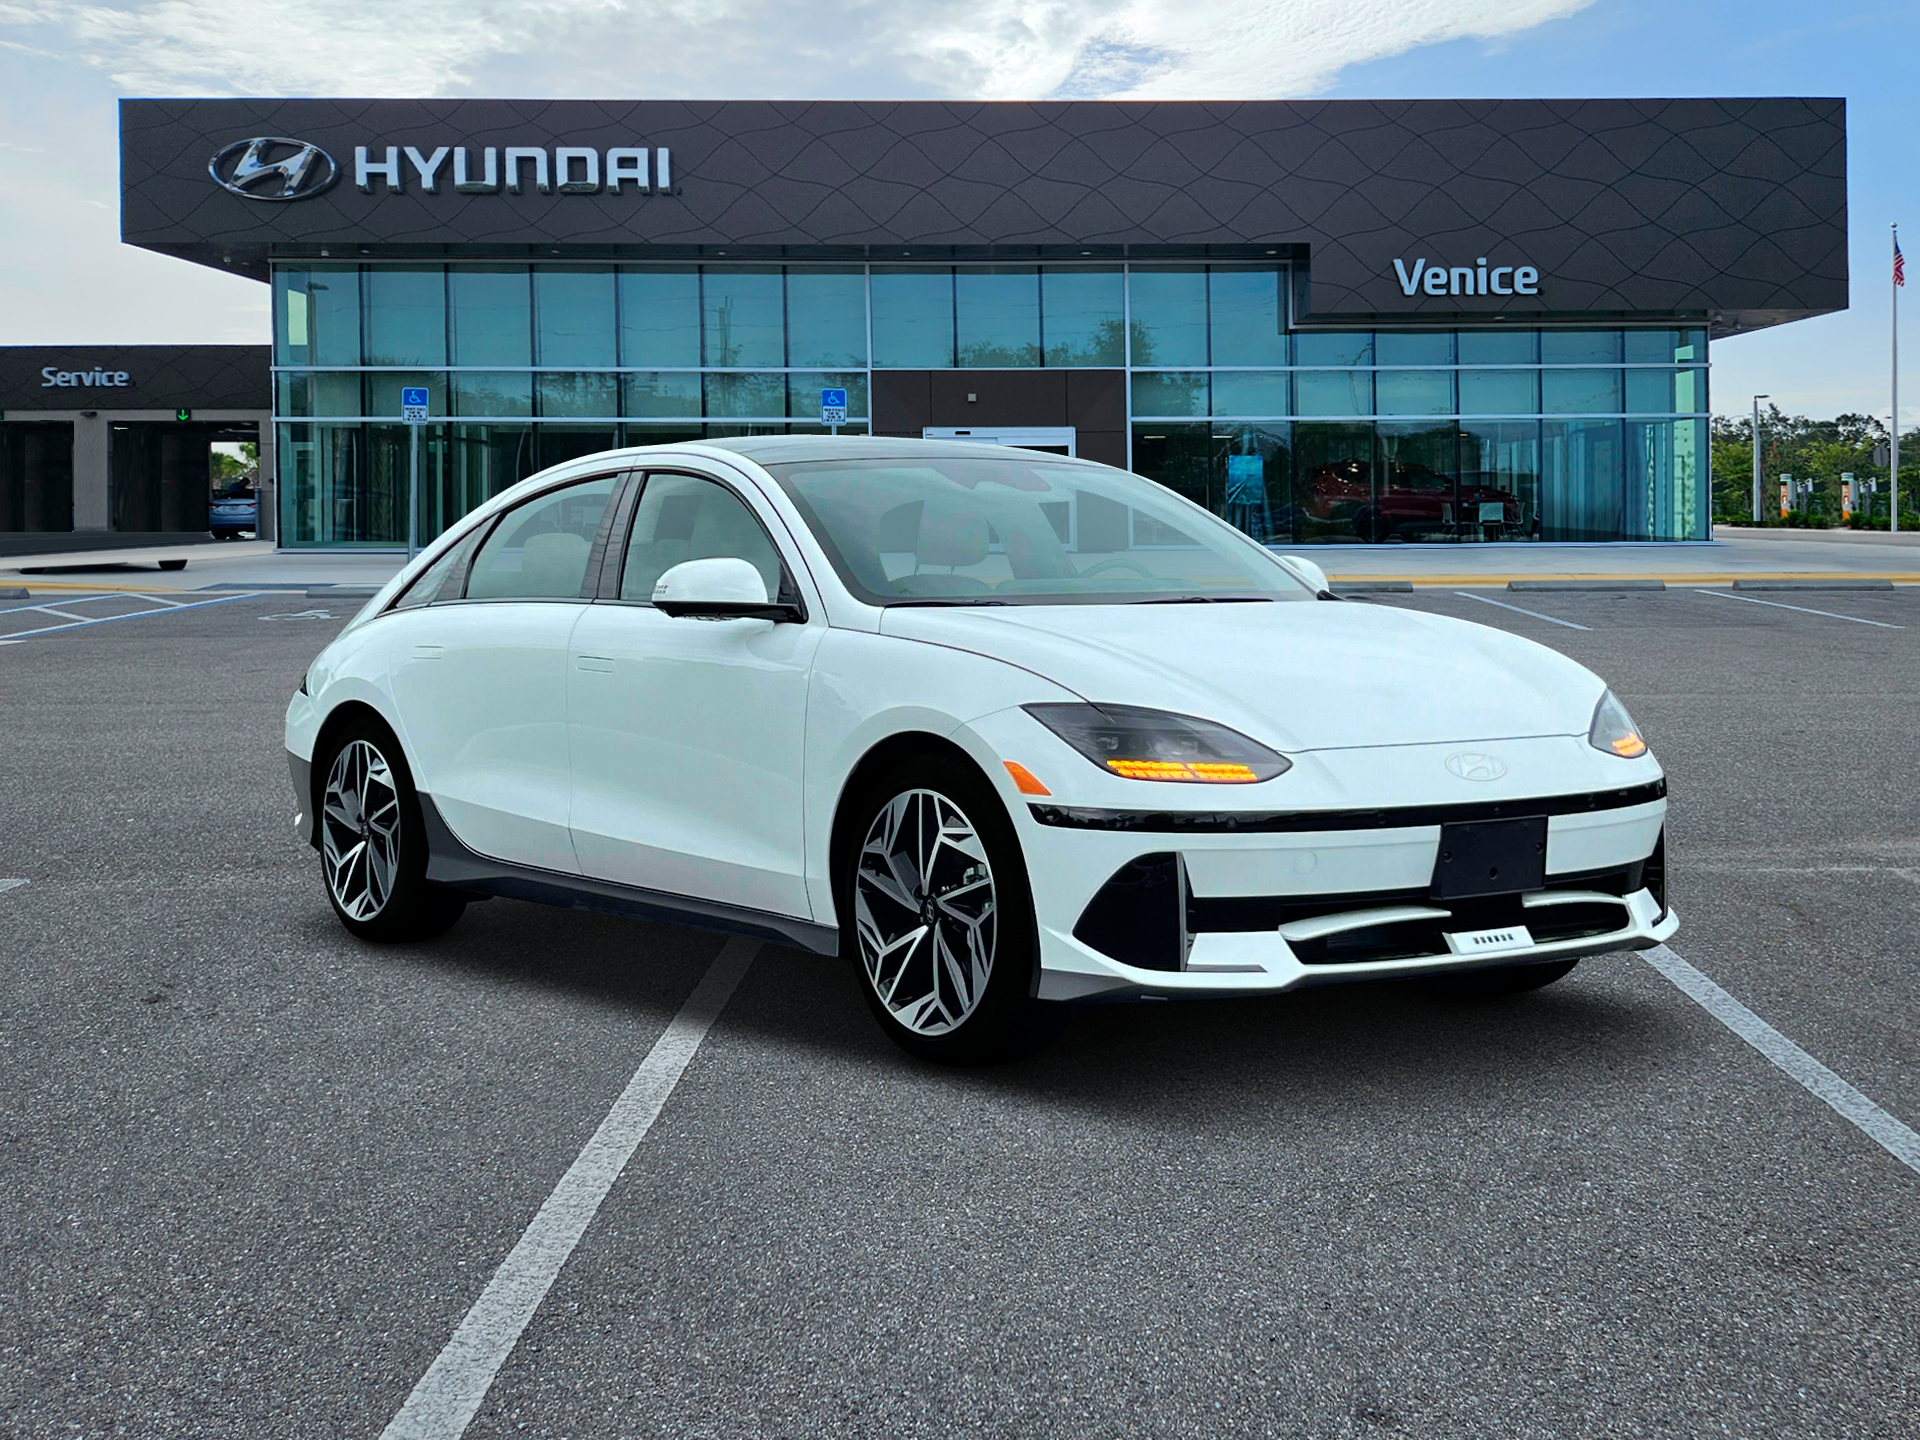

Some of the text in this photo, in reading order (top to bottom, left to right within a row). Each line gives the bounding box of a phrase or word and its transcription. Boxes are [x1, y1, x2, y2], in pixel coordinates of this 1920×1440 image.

[354, 146, 671, 194] HYUNDAI
[1392, 256, 1539, 296] Venice
[41, 366, 130, 387] Service
